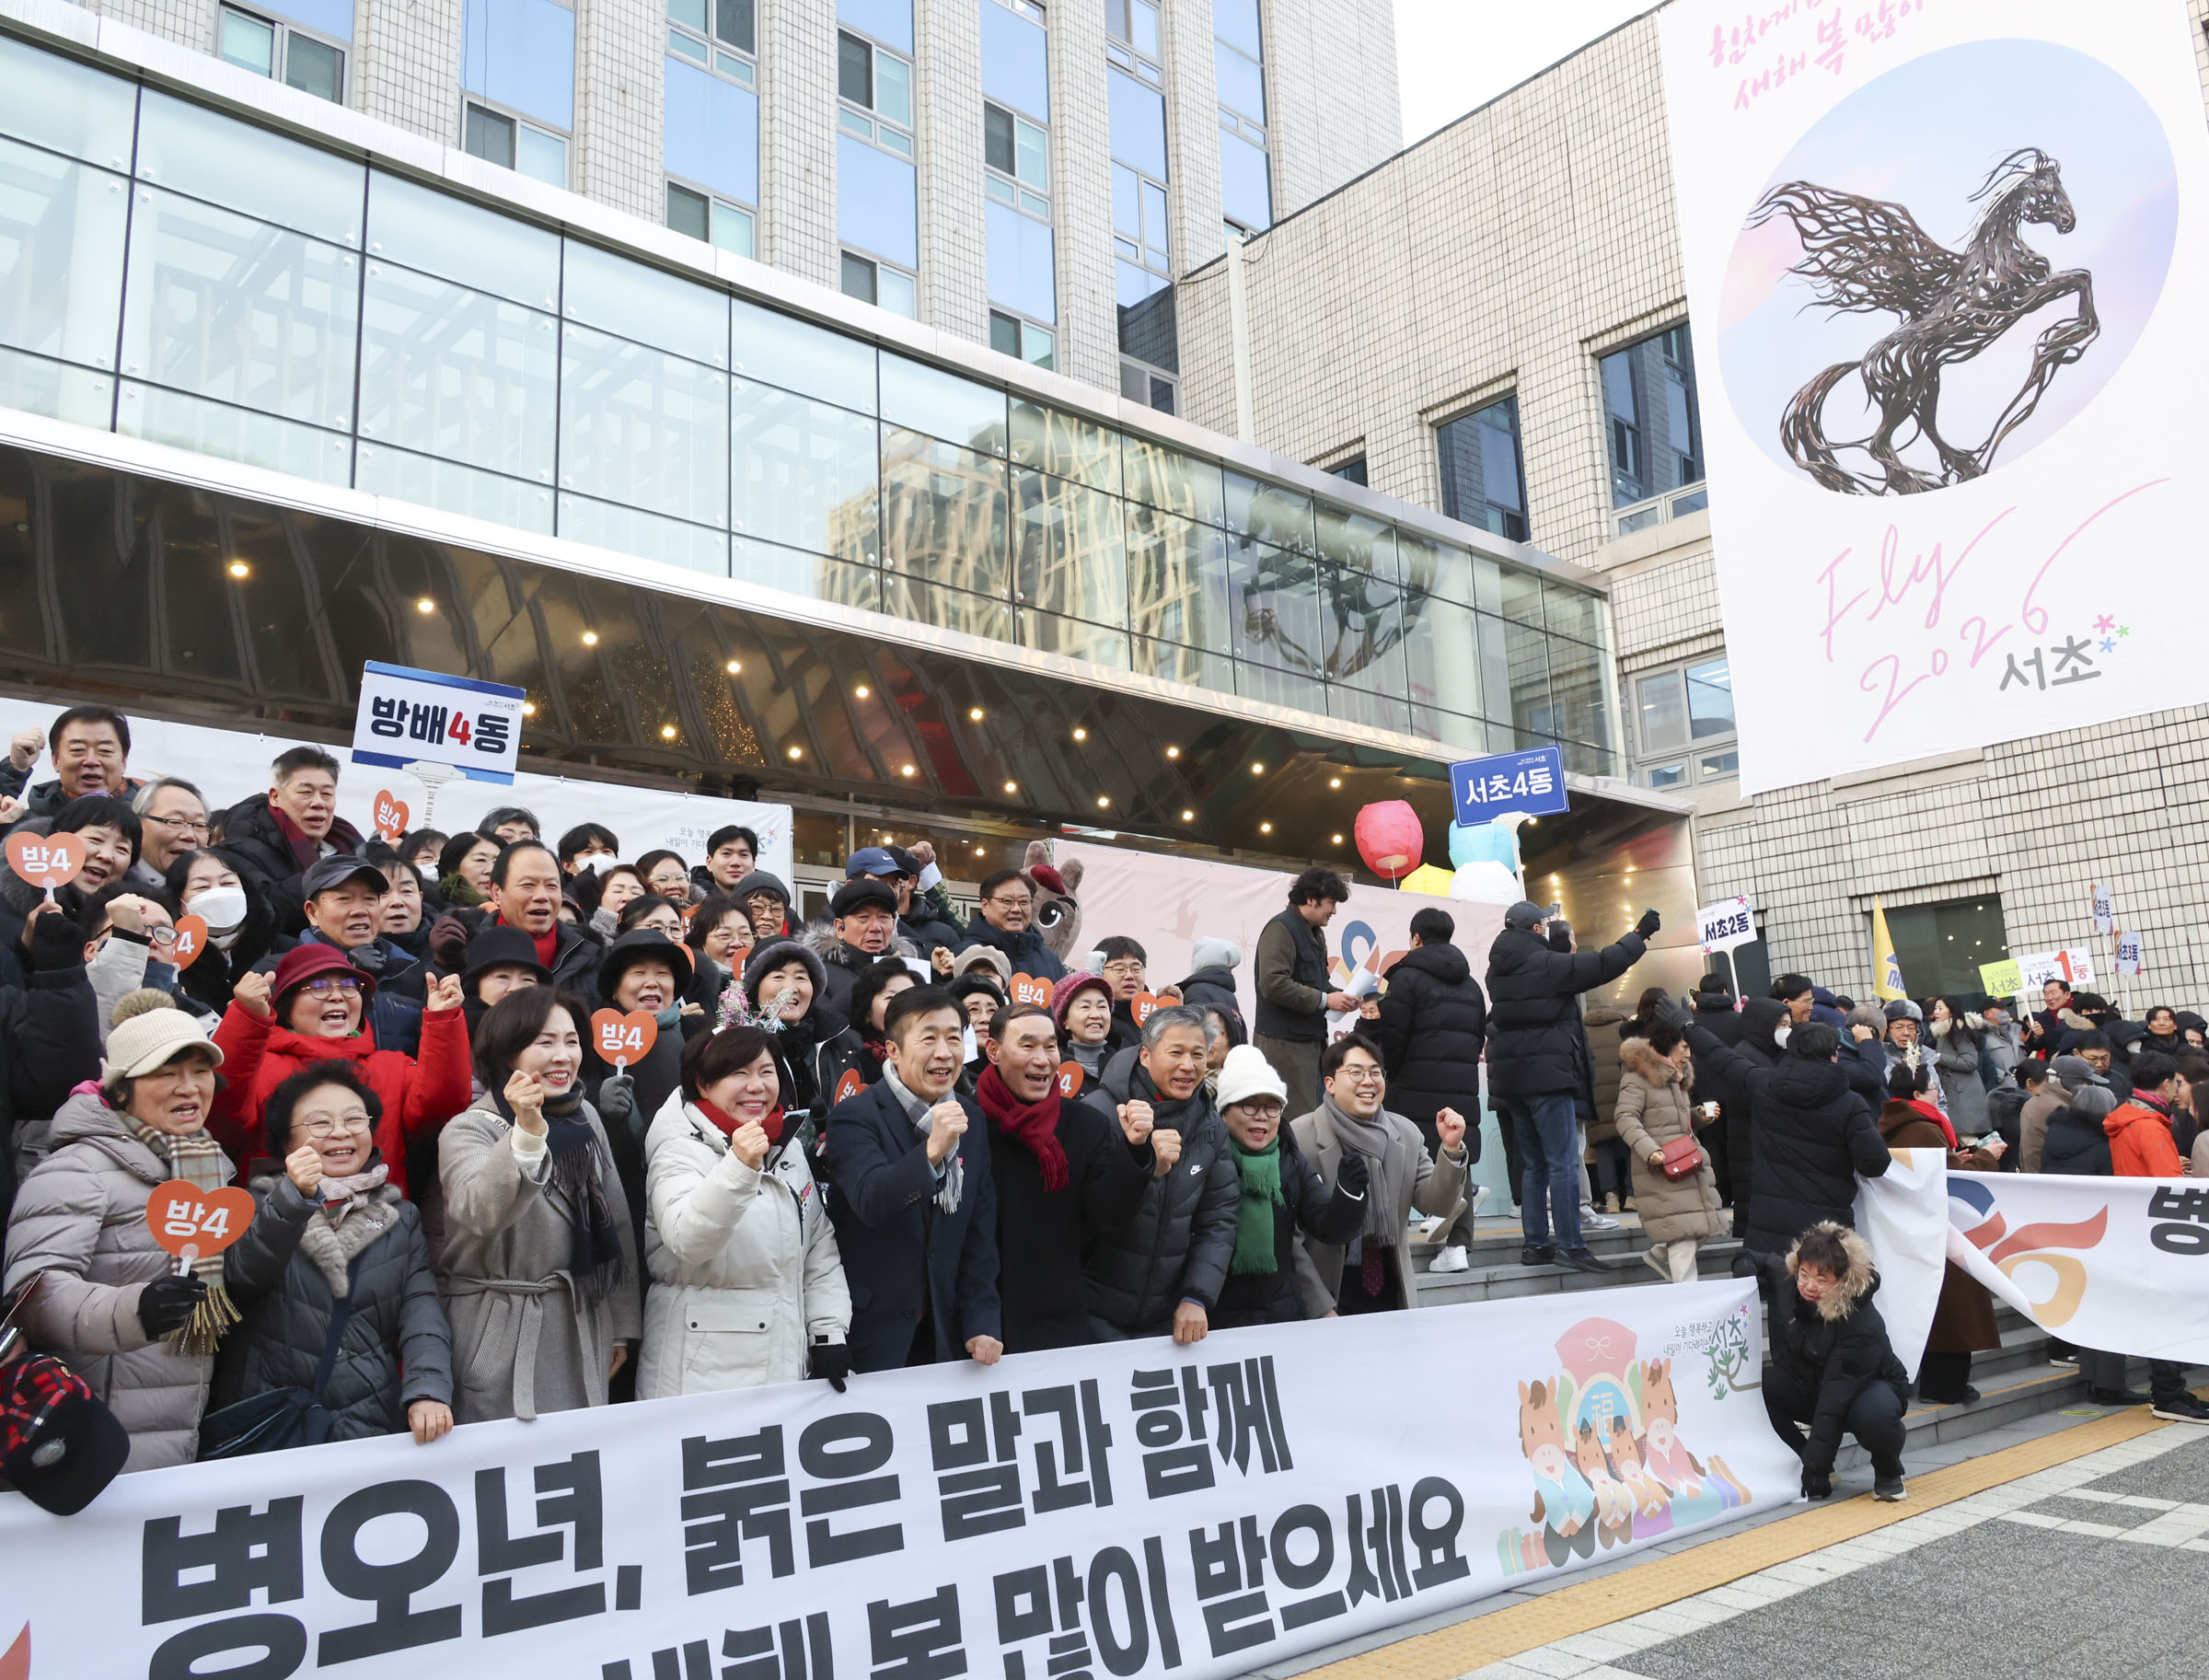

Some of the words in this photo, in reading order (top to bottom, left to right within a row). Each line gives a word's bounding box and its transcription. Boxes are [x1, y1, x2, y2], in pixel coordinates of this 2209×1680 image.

[1734, 51, 1807, 110] 새해
[1813, 7, 1848, 75] 복
[1817, 505, 2018, 662] Fly
[1860, 478, 2171, 743] 2026
[1999, 635, 2101, 690] 서초
[371, 696, 510, 754] 방배4동
[1465, 767, 1553, 805] 서초4동
[378, 801, 401, 831] 방4
[665, 836, 688, 848] 내일이
[679, 827, 695, 838] 오늘
[22, 846, 72, 873] 방4
[1706, 912, 1750, 942] 서초2동
[173, 931, 195, 955] 4
[1018, 982, 1046, 1006] 방4
[1991, 977, 2023, 994] 서초
[602, 1023, 644, 1051] 방4
[1057, 1071, 1072, 1094] 4
[164, 1199, 229, 1239] 방4
[1674, 1325, 1688, 1338] 오늘
[1689, 1321, 1713, 1338] 행복하고
[1711, 1314, 1744, 1349] 서초
[1663, 1340, 1682, 1357] 내일이
[142, 1449, 642, 1680] 병오년,
[680, 1411, 905, 1596] 붉은
[926, 1378, 1114, 1542] 말과
[1130, 1354, 1294, 1500] 함께
[993, 1535, 1183, 1680] 많이
[1188, 1476, 1471, 1658] 받으세요
